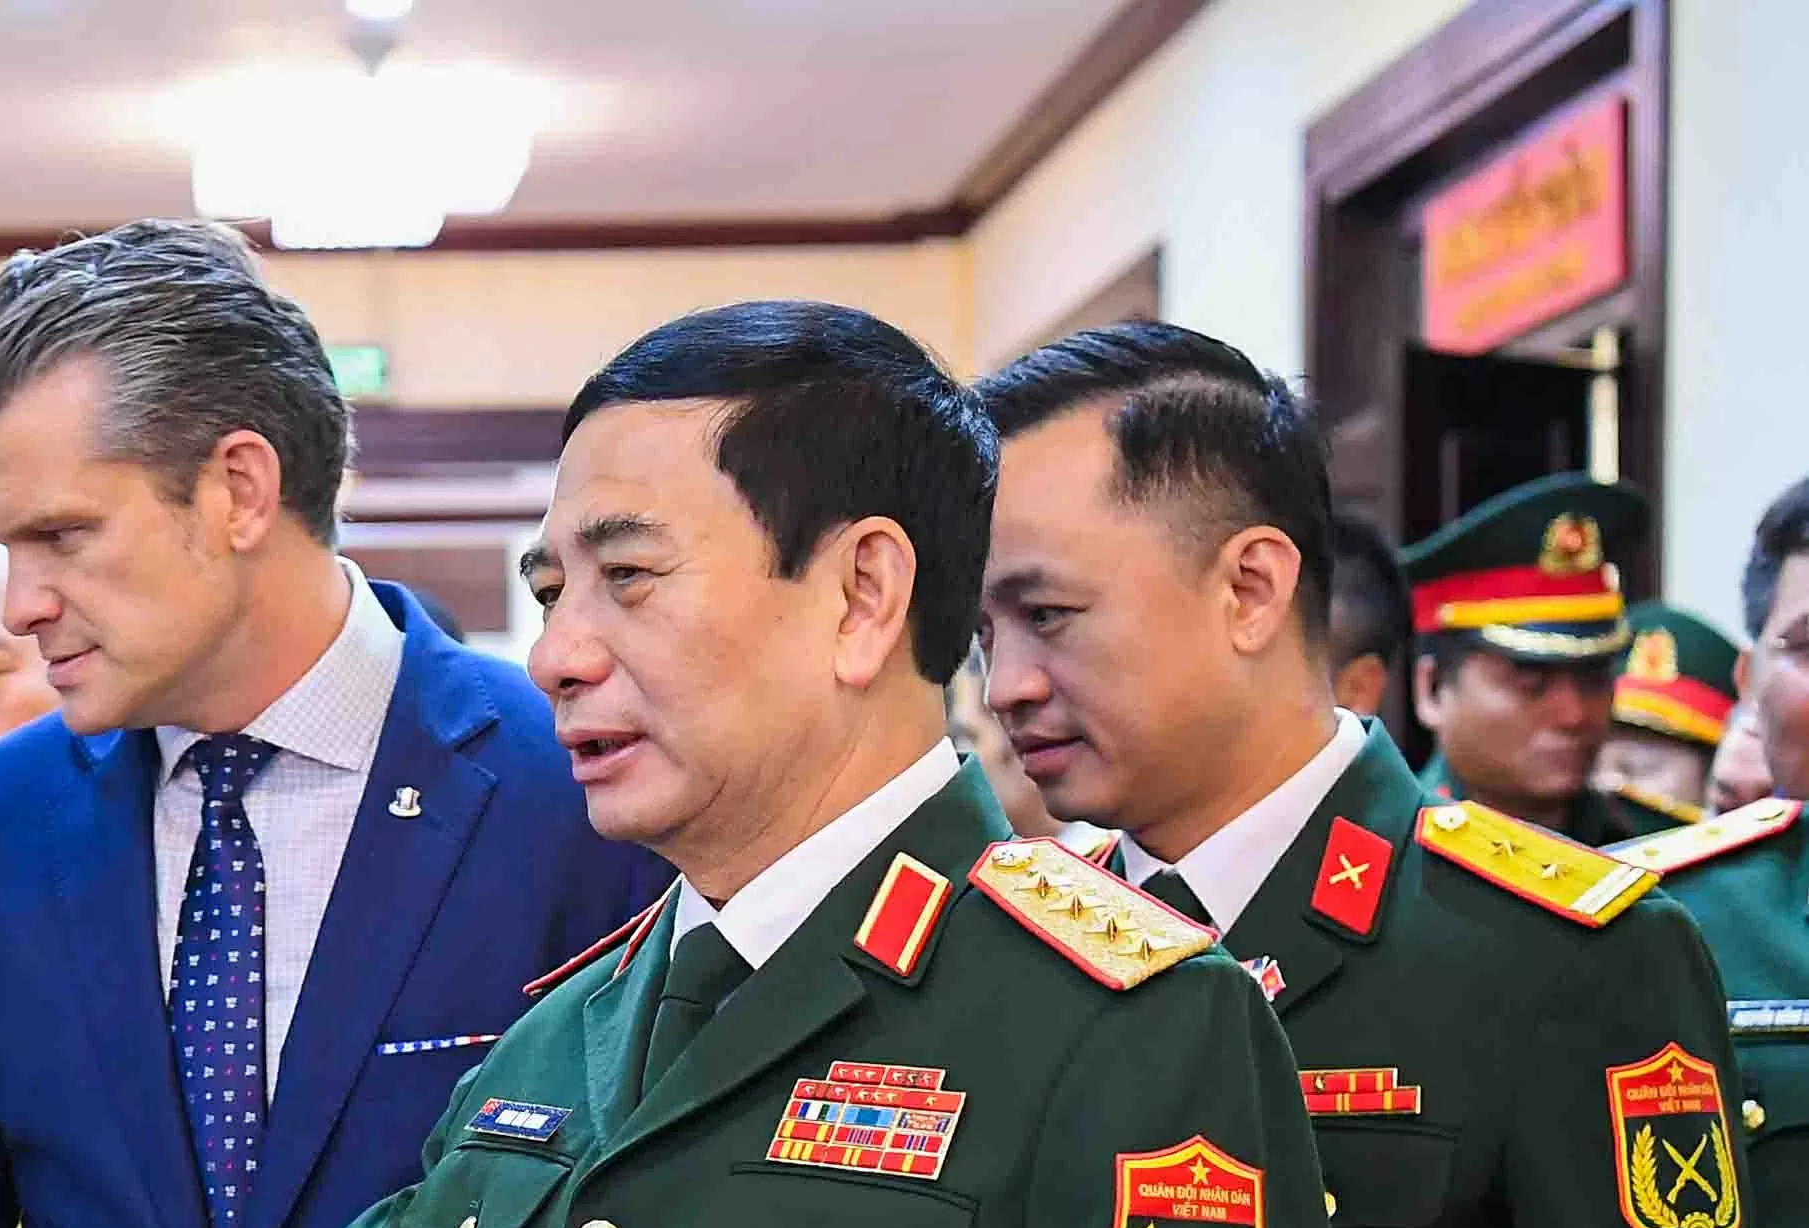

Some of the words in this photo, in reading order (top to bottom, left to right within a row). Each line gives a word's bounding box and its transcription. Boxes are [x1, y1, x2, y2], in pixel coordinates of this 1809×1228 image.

[1138, 1182, 1175, 1198] QUÂN
[1177, 1183, 1197, 1200] ĐỘI
[1199, 1185, 1229, 1203] NHÂN
[1230, 1188, 1251, 1206] DÂN
[1172, 1201, 1199, 1218] VIỆT
[1201, 1205, 1226, 1219] NAM
